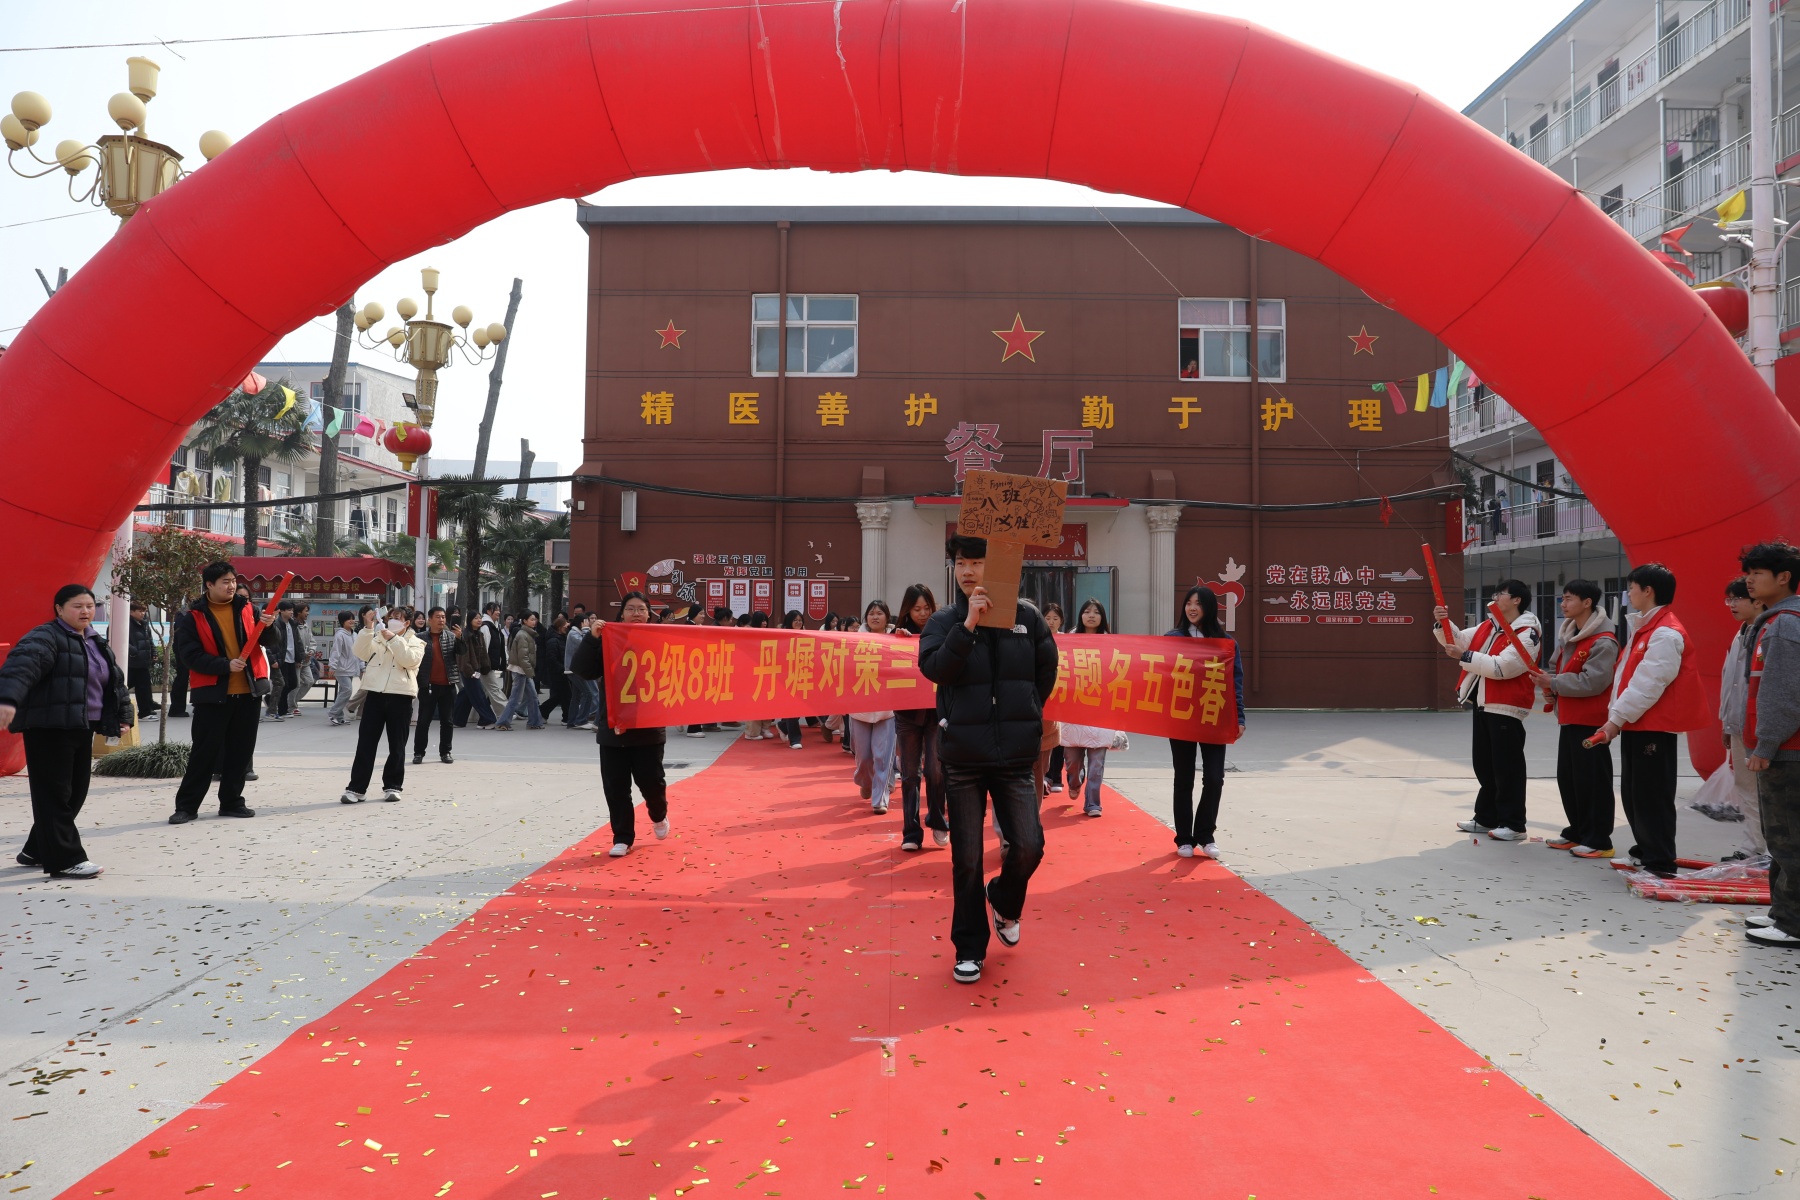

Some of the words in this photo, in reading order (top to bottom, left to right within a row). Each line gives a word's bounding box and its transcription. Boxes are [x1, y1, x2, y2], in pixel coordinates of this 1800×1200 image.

[641, 391, 938, 427] 精医善护
[1081, 395, 1383, 432] 勤于护理
[944, 421, 1094, 483] 餐厅
[1266, 564, 1375, 585] 党在我心中
[1290, 590, 1396, 611] 永远跟党走
[619, 639, 736, 708] 23级8班
[752, 637, 937, 702] 丹墀对策三
